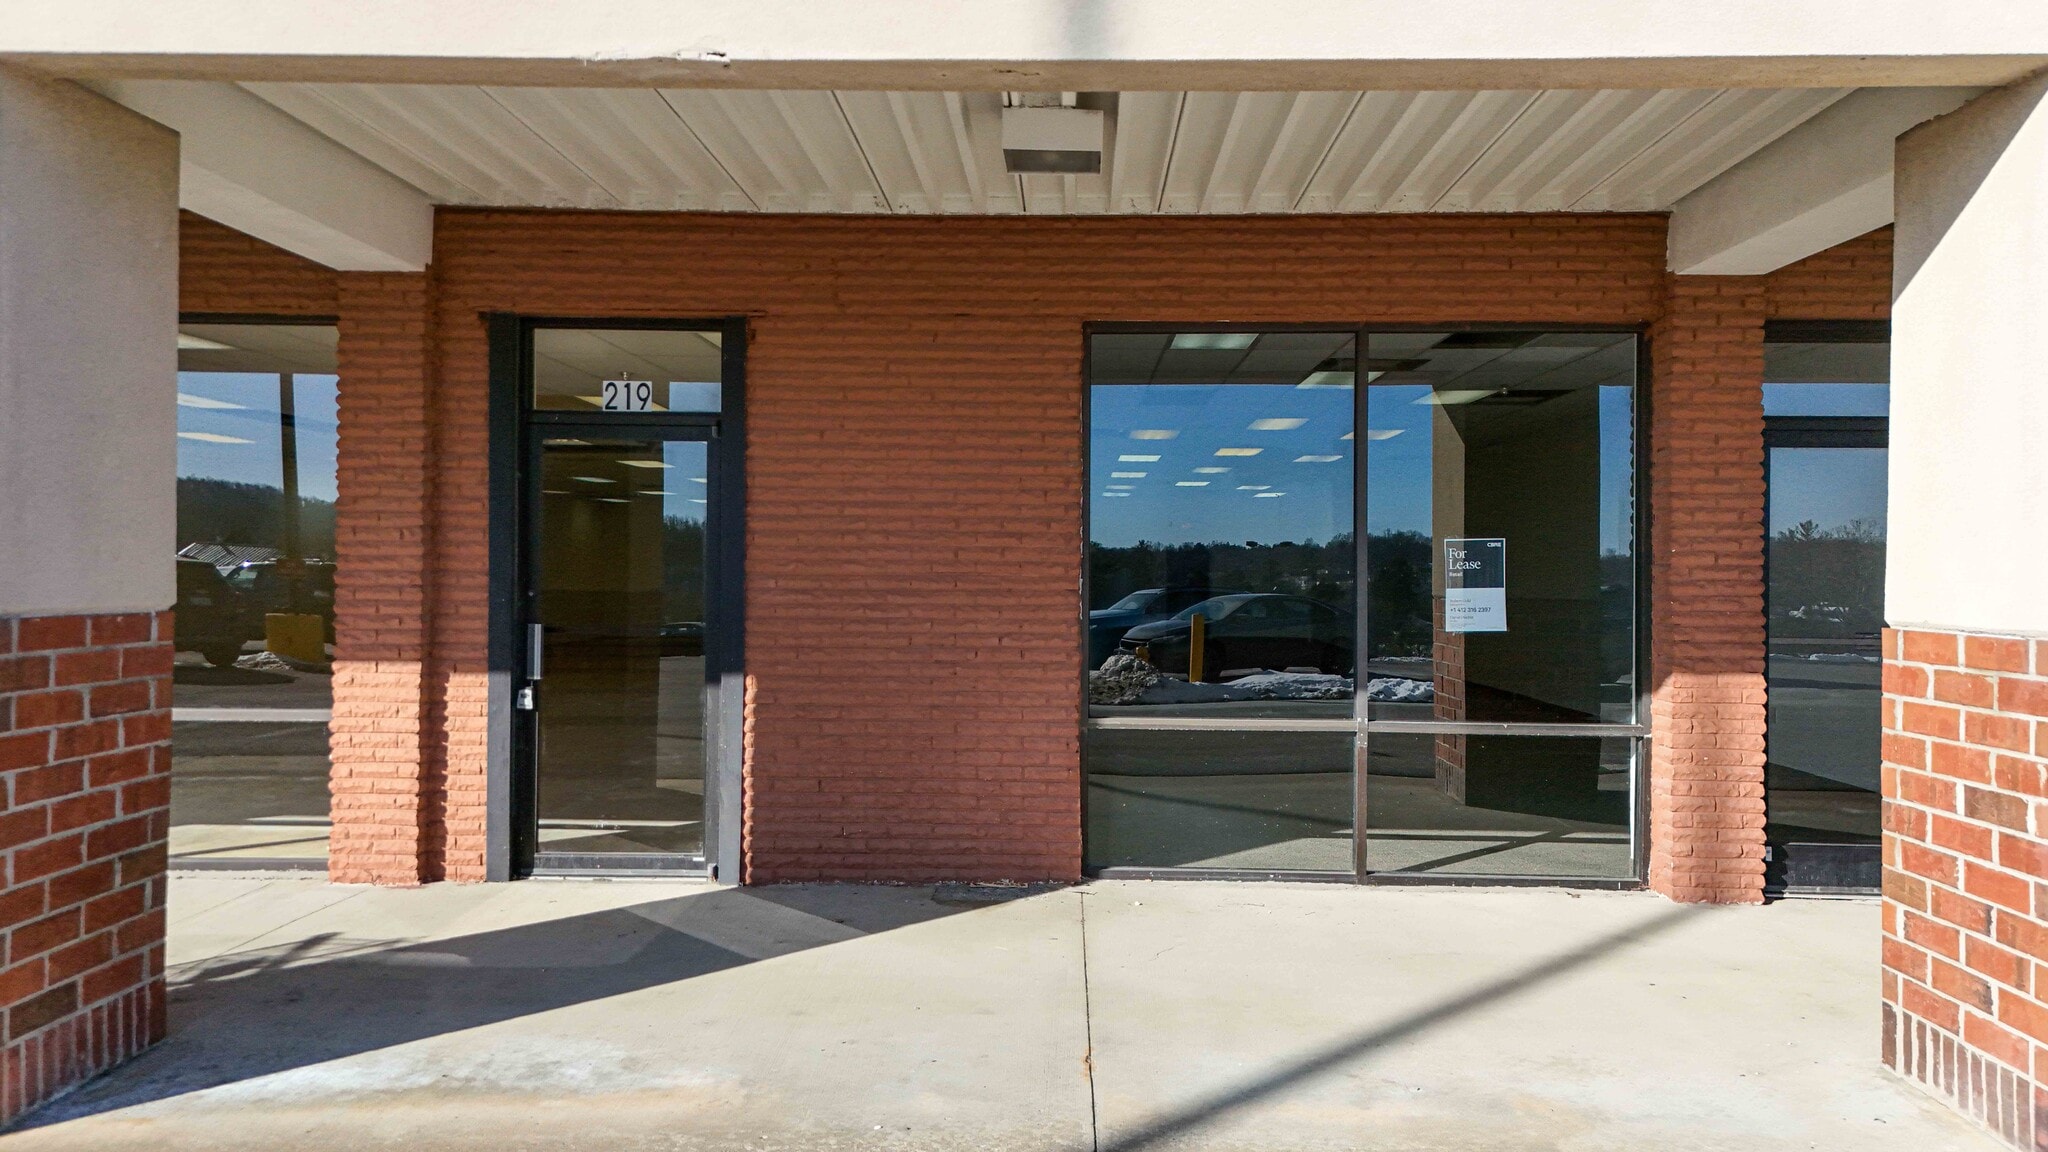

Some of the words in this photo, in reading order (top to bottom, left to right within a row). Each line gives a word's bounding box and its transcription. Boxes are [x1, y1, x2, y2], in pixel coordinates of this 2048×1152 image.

[605, 382, 650, 410] 219
[1449, 548, 1467, 559] For
[1449, 559, 1481, 570] Lease
